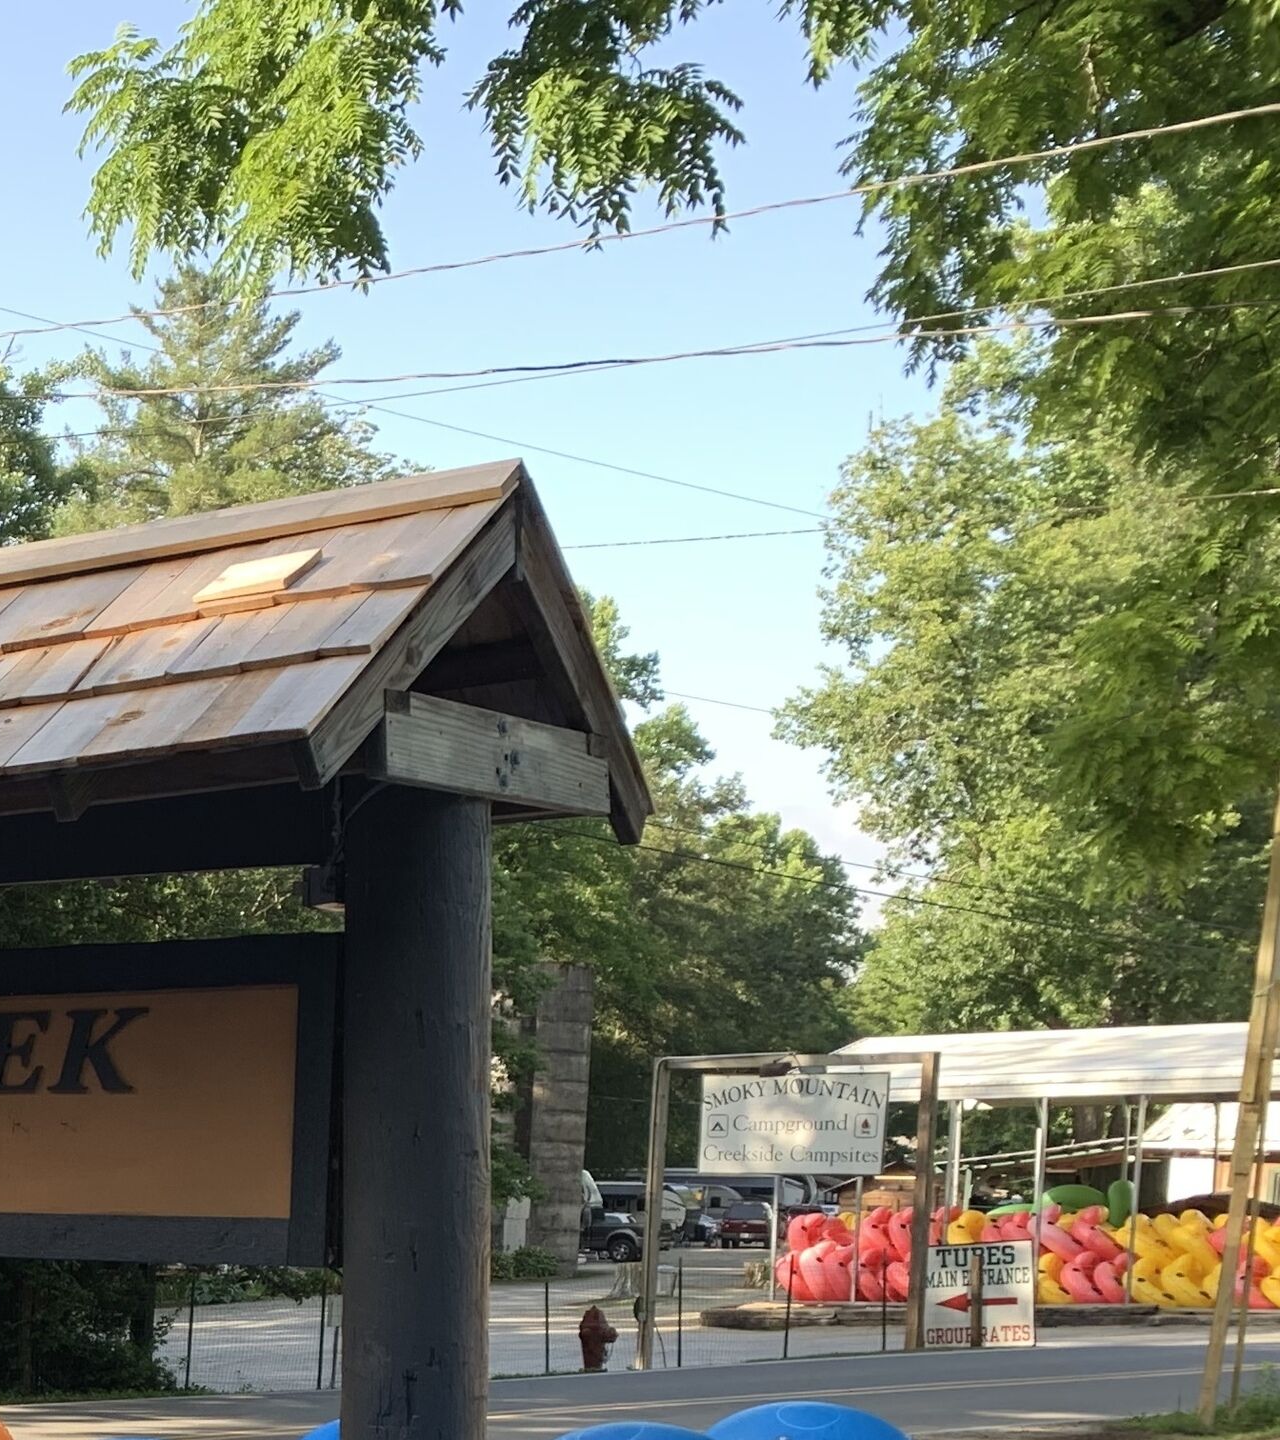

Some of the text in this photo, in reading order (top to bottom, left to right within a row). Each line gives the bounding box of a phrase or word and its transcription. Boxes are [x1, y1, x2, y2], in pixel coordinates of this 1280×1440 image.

[703, 1078, 886, 1111] SMOKY MOUNTAIN
[733, 1113, 848, 1135] Campground
[703, 1144, 879, 1166] Creekside Campsites
[926, 1266, 1030, 1288] MAIN ETRANCE
[980, 1325, 1031, 1343] RATES
